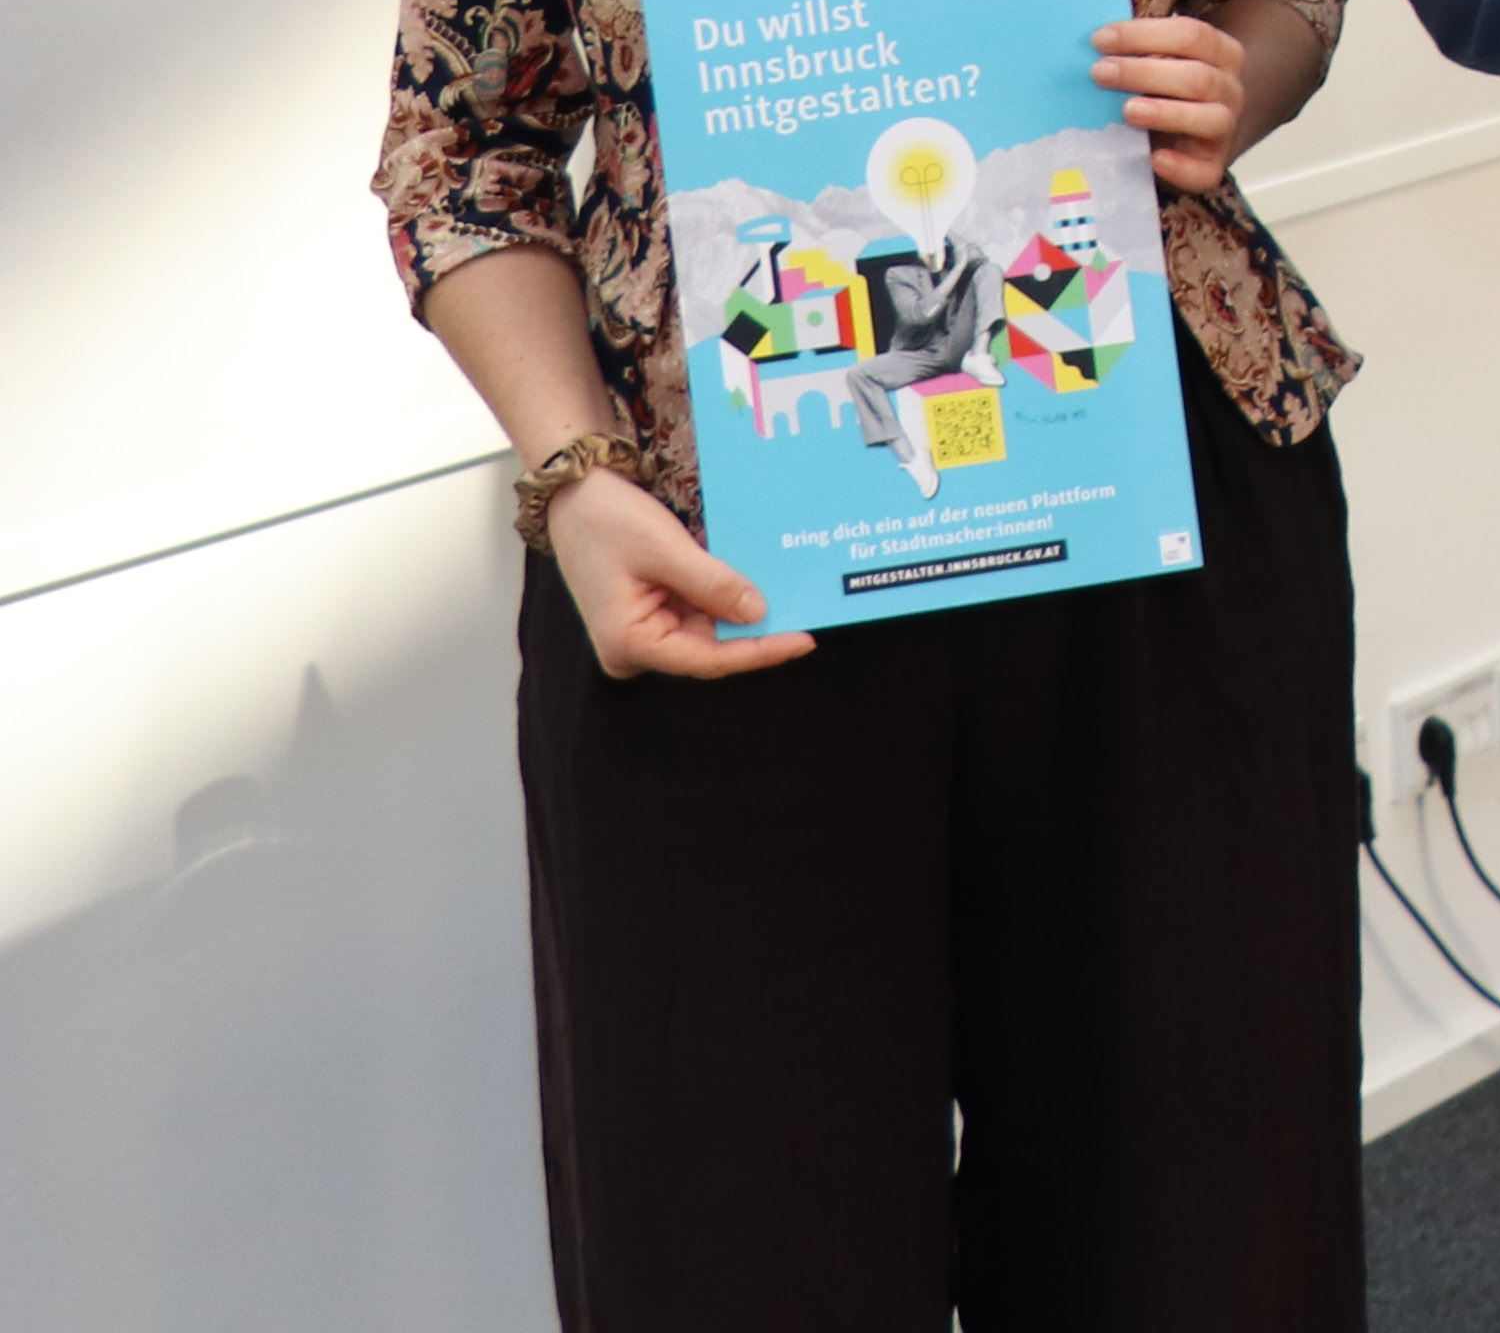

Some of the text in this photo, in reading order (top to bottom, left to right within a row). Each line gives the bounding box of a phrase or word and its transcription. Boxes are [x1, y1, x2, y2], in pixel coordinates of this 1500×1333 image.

[693, 17, 744, 51] Du
[699, 33, 900, 93] Innsbruck
[704, 64, 982, 135] mitgestalten?
[782, 485, 1115, 549] Bring dich ein auf der neuen Plattform
[849, 514, 1053, 560] für Stadtmacher:innen!
[849, 545, 1061, 589] MITGESTALTEN.INNSBRUCK.GV.AT
